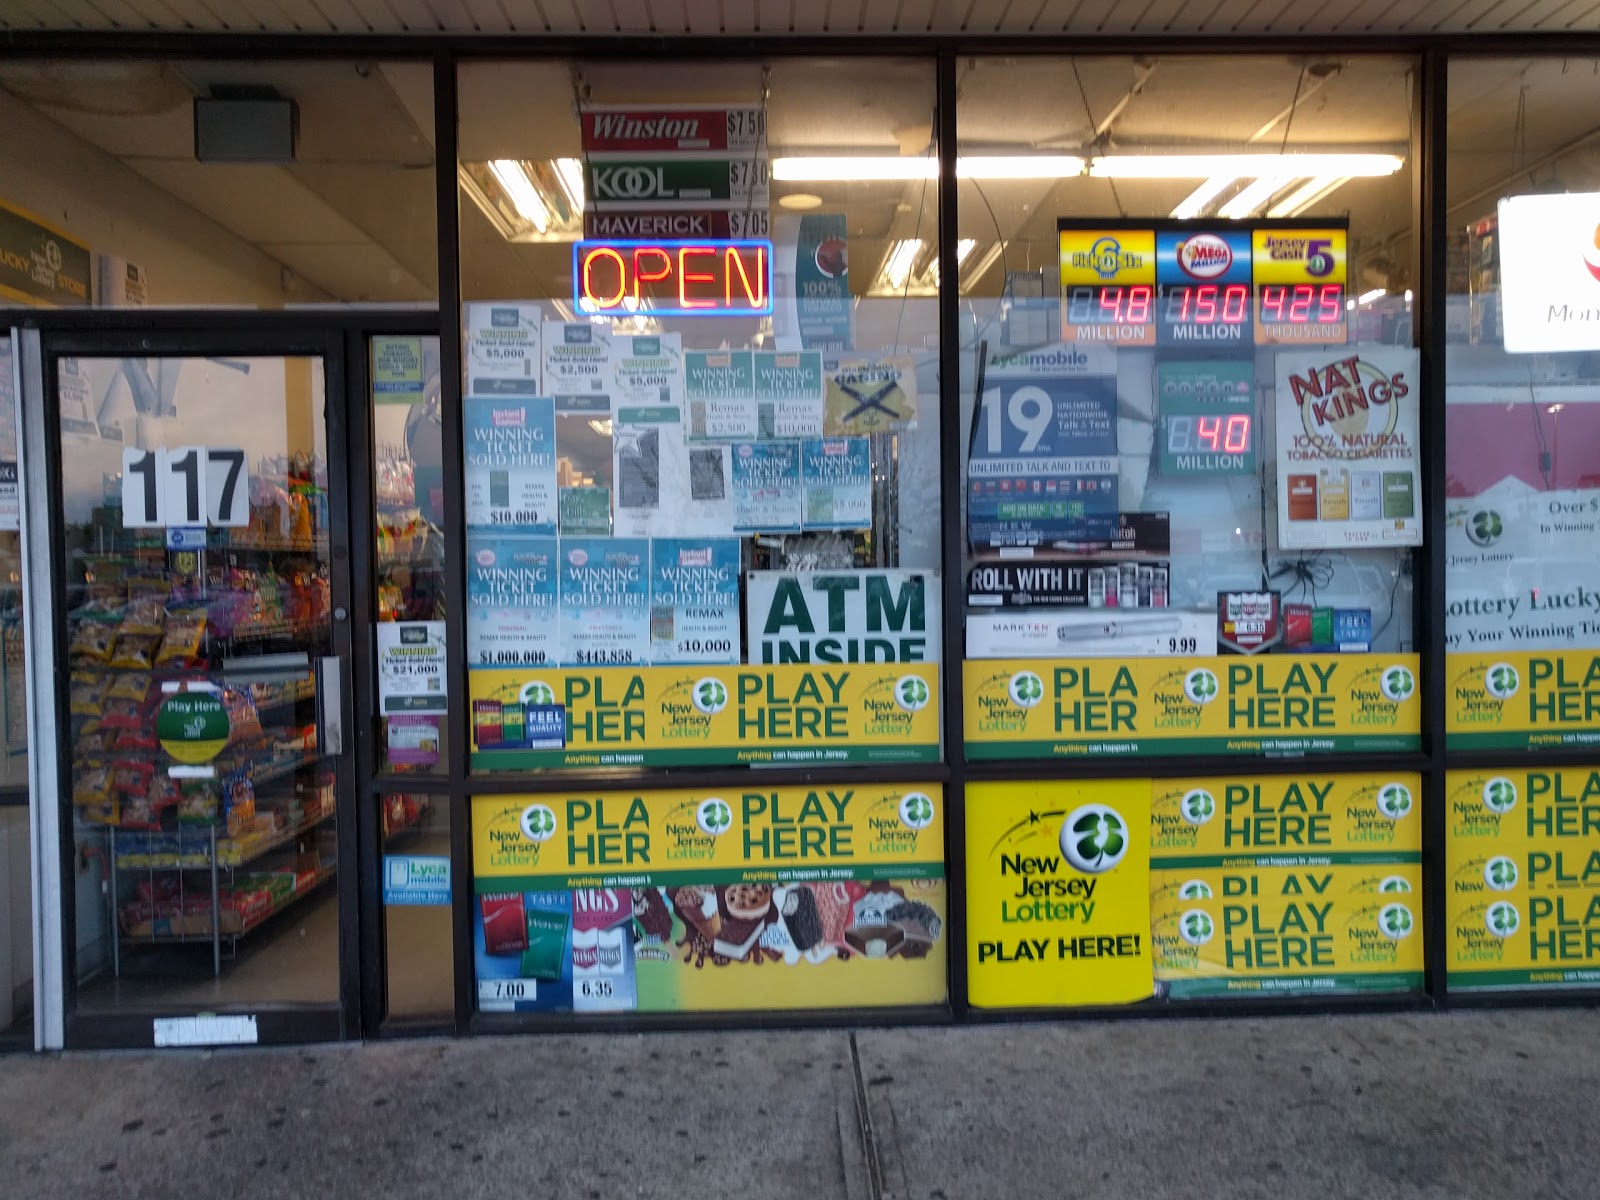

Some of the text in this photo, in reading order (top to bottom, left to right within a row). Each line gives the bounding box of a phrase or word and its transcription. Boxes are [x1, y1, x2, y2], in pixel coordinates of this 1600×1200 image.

[593, 112, 699, 139] Winston
[592, 166, 674, 198] KOOL
[592, 215, 704, 234] MAVERICK
[1263, 235, 1306, 249] Jersey
[1270, 239, 1335, 277] Cash 5
[583, 247, 764, 309] OPEN
[1099, 285, 1153, 323] 4.8
[1180, 285, 1248, 323] 150
[1263, 285, 1341, 323] 425
[1077, 326, 1145, 340] MILLION
[1173, 325, 1241, 339] MILLION
[1264, 324, 1341, 339] THOUSAND
[692, 368, 745, 379] WINNING
[761, 368, 814, 379] WINNING
[1289, 354, 1362, 406] NAT
[702, 379, 737, 389] TICKET
[771, 379, 805, 389] TICKET
[1312, 372, 1409, 427] KINGS
[981, 385, 1053, 454] 19
[1058, 421, 1079, 430] Talk
[1089, 421, 1110, 430] Text
[474, 428, 544, 442] WINNING
[1198, 414, 1251, 453] 40
[1293, 432, 1408, 448] 100% NATURAL
[486, 441, 533, 454] TICKET
[1287, 447, 1413, 462] TOBACCO CIGARETTES
[469, 453, 550, 467] SOLD HERE!
[739, 457, 792, 470] WINNING
[809, 456, 862, 467] WINNING
[970, 460, 1110, 473] UNLIMITED TALK AND TEXT TO
[1176, 455, 1244, 470] MILLION
[748, 468, 782, 477] TICKET
[819, 466, 852, 476] TICKET
[129, 451, 245, 523] 117
[1549, 500, 1585, 515] Over
[491, 509, 538, 525] $10,000
[1540, 522, 1594, 534] In Winning
[1452, 553, 1514, 566] Jersey Lottery
[477, 568, 547, 582] WINNING
[569, 568, 639, 581] WINNING
[661, 567, 732, 580] WINNING
[971, 567, 1084, 591] ROLL WITH IT
[488, 581, 536, 593] TICKET
[581, 581, 628, 593] TICKET
[672, 580, 721, 593] TICKET
[471, 593, 553, 607] SOLD HERE!
[563, 593, 645, 607] SOLD HERE!
[655, 593, 735, 607] SOLD HERE!
[763, 573, 926, 635] ATM
[1446, 585, 1600, 620] ottery Lucky
[685, 609, 724, 619] REMAX
[992, 623, 1048, 632] MARKTEN
[1468, 622, 1575, 643] Your Winning
[678, 639, 731, 654] $10,000
[762, 636, 926, 664] INSIDE
[1168, 637, 1197, 653] 9.99
[479, 649, 546, 665] $1,000,000
[1228, 662, 1338, 695] PLAY
[1529, 656, 1600, 689] PLA
[738, 671, 851, 706] PLAY
[1054, 665, 1138, 699] PLA
[565, 675, 645, 708] PLA
[167, 700, 221, 714] Play Here
[661, 702, 692, 714] New
[864, 699, 894, 711] New
[1228, 695, 1336, 729] HERE
[1529, 690, 1600, 724] HER
[529, 711, 562, 724] FEEL
[669, 714, 712, 727] Jersey
[738, 706, 850, 739] HERE
[872, 711, 913, 723] Jersey
[1054, 699, 1138, 733] HER
[529, 724, 562, 733] QUALITY
[565, 710, 646, 743] HER
[661, 727, 710, 739] Lottery
[864, 723, 912, 736] Lottery
[772, 752, 786, 761] can
[787, 750, 815, 762] happen
[816, 750, 823, 759] in
[824, 749, 849, 760] Jersey.
[1526, 771, 1600, 805] PLA
[1224, 780, 1335, 815] PLAY
[566, 798, 650, 831] PLA
[741, 789, 855, 825] PLAY
[1527, 804, 1600, 838] HER
[1224, 814, 1332, 847] HERE
[567, 832, 651, 866] HER
[743, 825, 854, 860] HERE
[411, 862, 447, 876] Lyca
[1001, 852, 1060, 876] New
[1528, 849, 1600, 883] PLA
[778, 871, 792, 879] can
[792, 869, 821, 881] happen
[821, 870, 828, 878] in
[829, 869, 854, 879] Jersey.
[1015, 875, 1097, 900] Jersey
[531, 894, 566, 906] TASTE
[575, 888, 619, 913] NGS
[1002, 899, 1095, 924] Lottery
[1223, 901, 1334, 936] PLAY
[1529, 894, 1600, 927] PLA
[978, 932, 1141, 963] PLAY HERE!
[1530, 926, 1600, 962] HER
[573, 949, 598, 963] WINGS
[599, 950, 621, 963] WINGS
[1225, 935, 1335, 970] HERE
[494, 981, 525, 997] 7.00
[582, 980, 613, 997] 6.35
